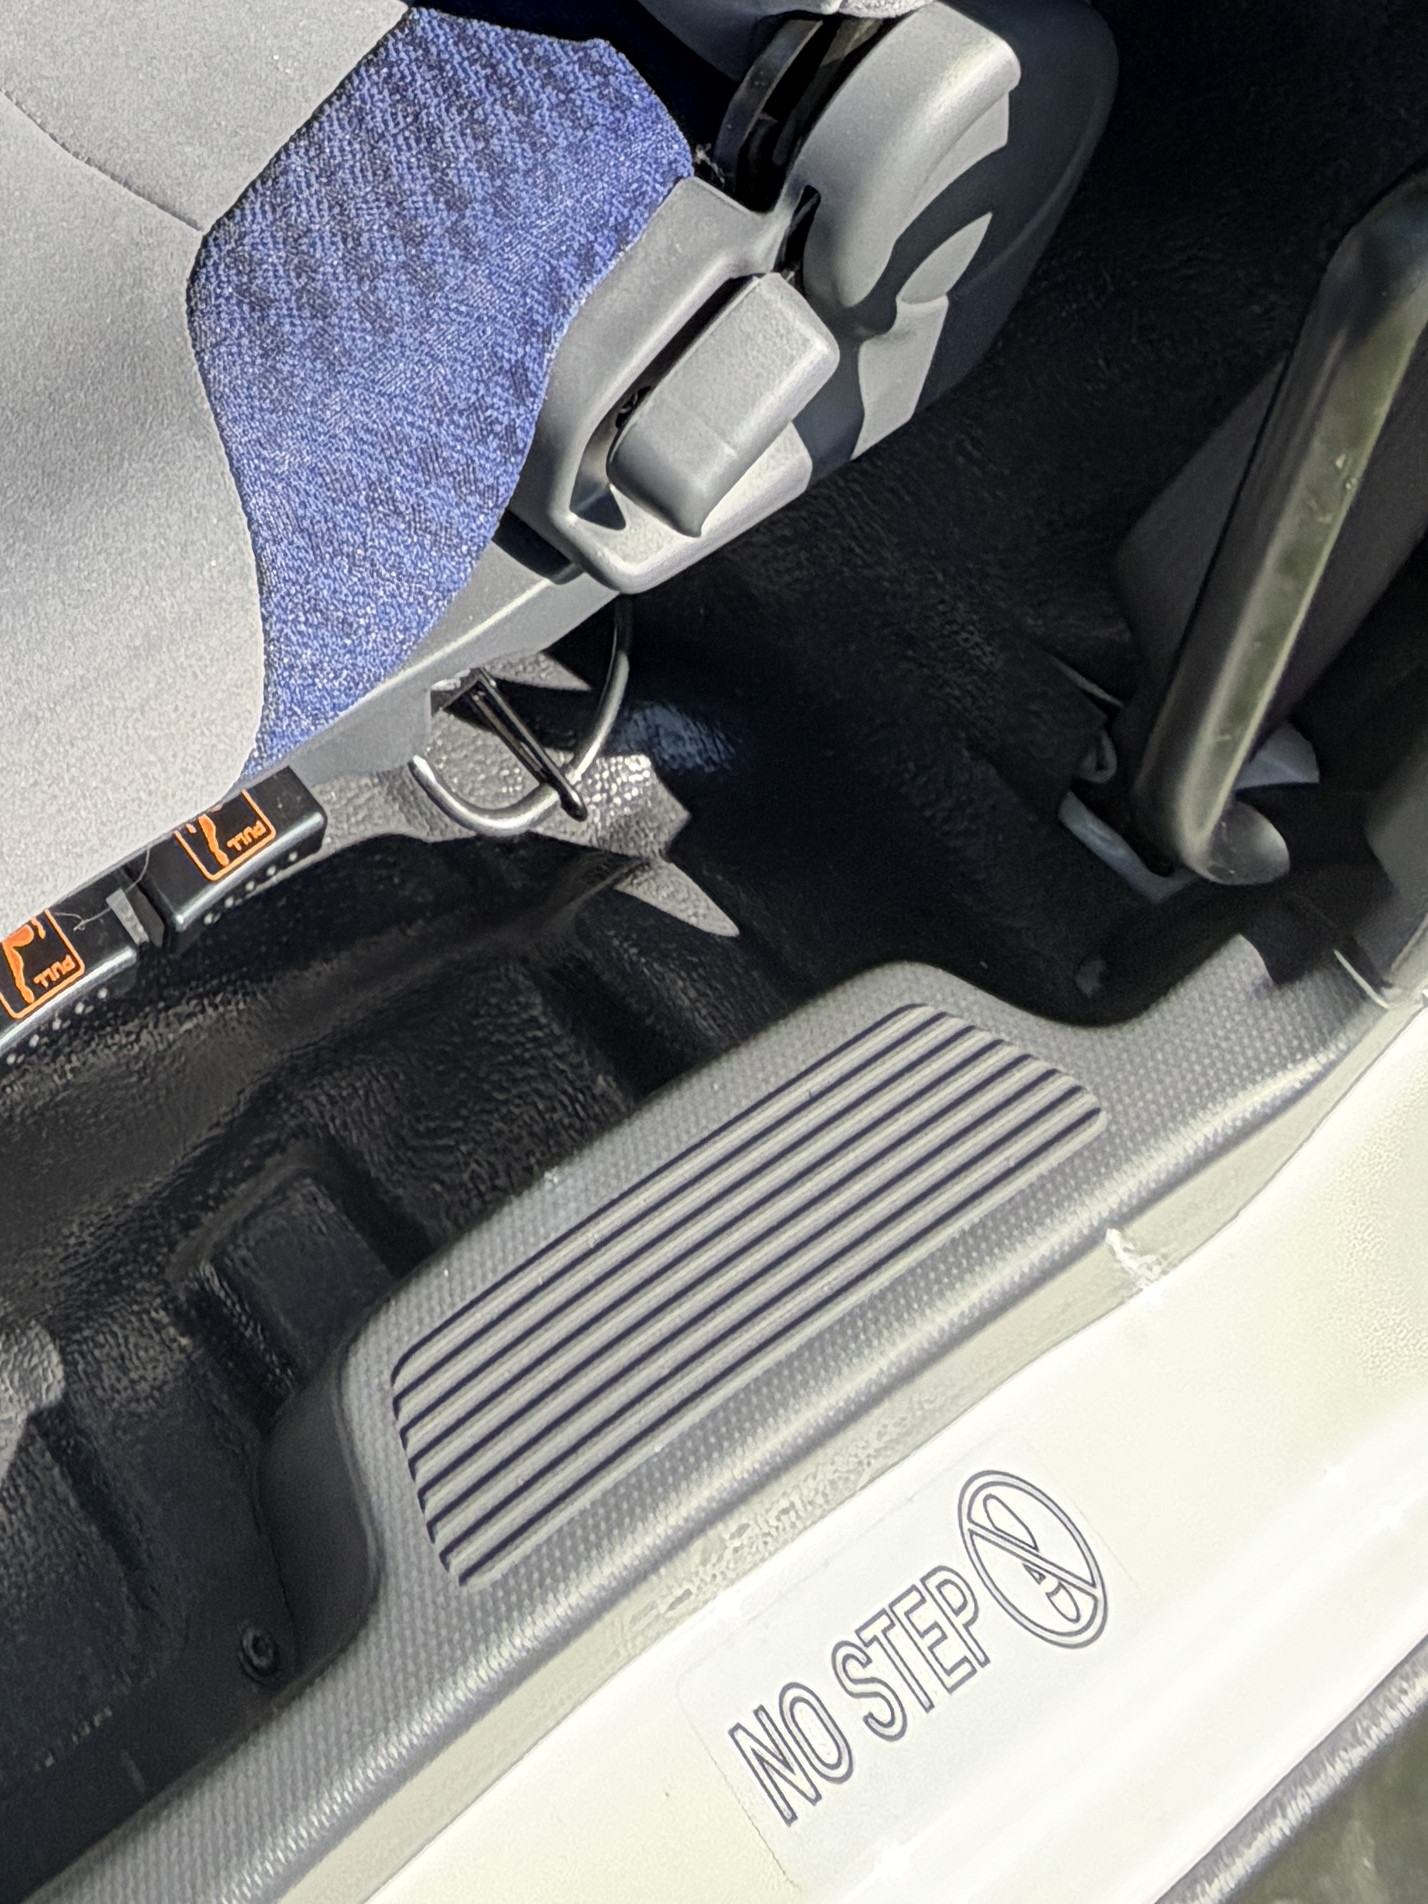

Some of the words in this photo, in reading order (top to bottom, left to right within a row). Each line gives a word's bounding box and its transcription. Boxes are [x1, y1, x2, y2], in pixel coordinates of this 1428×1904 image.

[226, 819, 267, 852] PULL
[33, 954, 77, 989] PULL
[727, 1681, 855, 1828] NO
[830, 1564, 992, 1744] STEP
